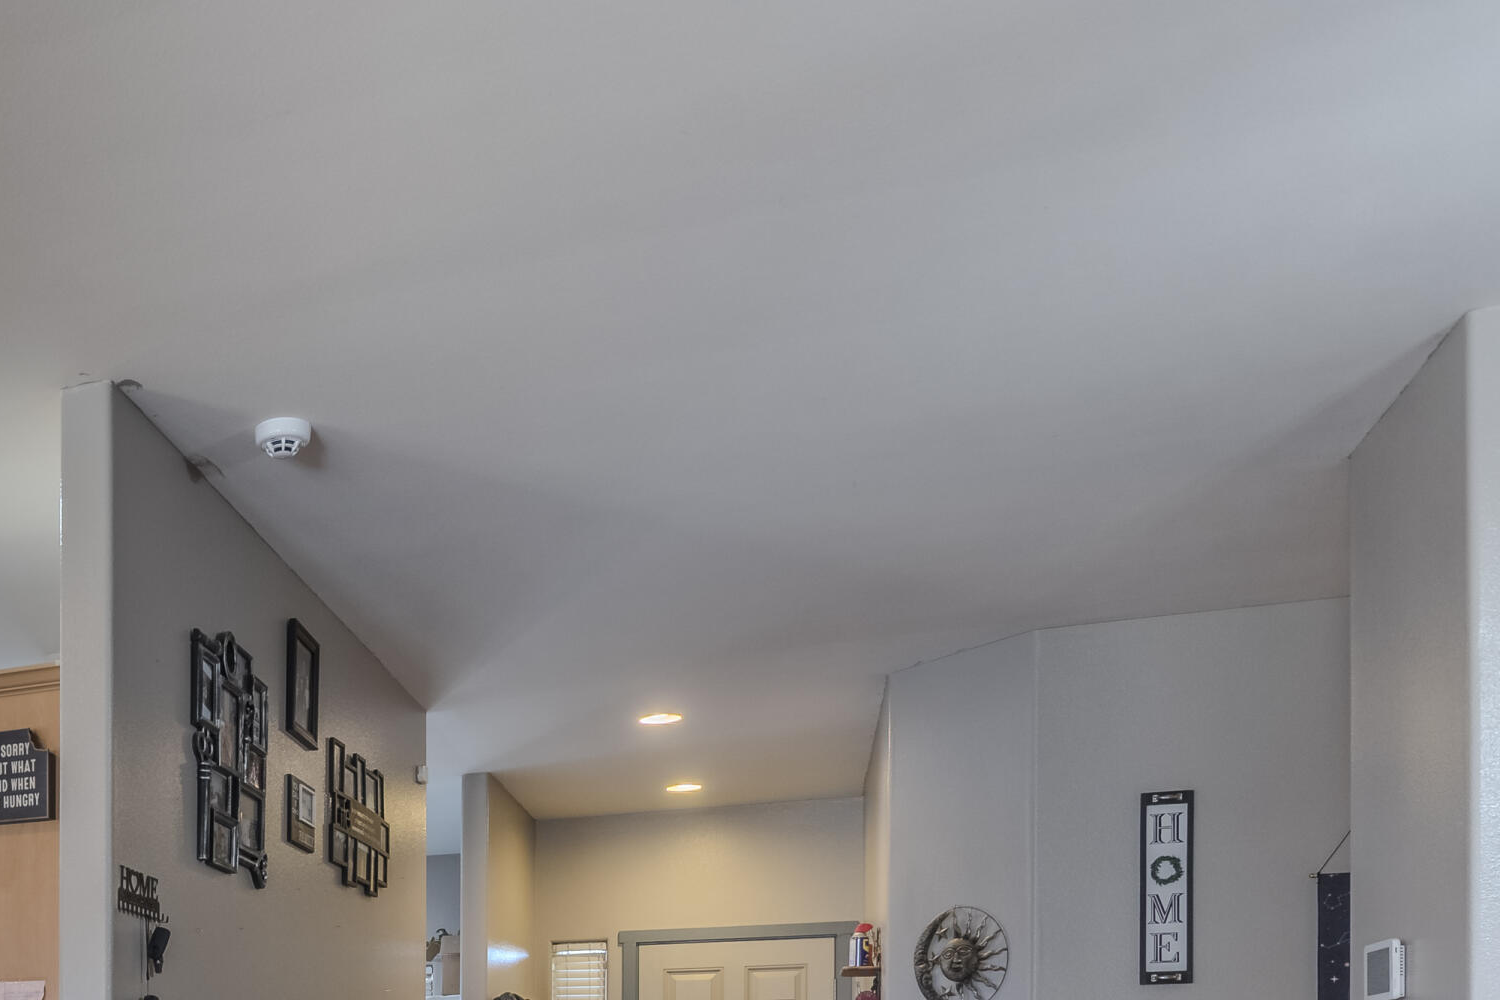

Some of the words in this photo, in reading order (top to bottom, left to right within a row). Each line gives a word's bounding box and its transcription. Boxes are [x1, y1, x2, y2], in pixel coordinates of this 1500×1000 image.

[0, 742, 30, 757] SORRY
[11, 759, 36, 774] WHAT
[11, 776, 36, 792] WHEN
[3, 793, 40, 809] HUNGRY
[119, 864, 159, 900] HOME
[1148, 812, 1184, 964] HOME
